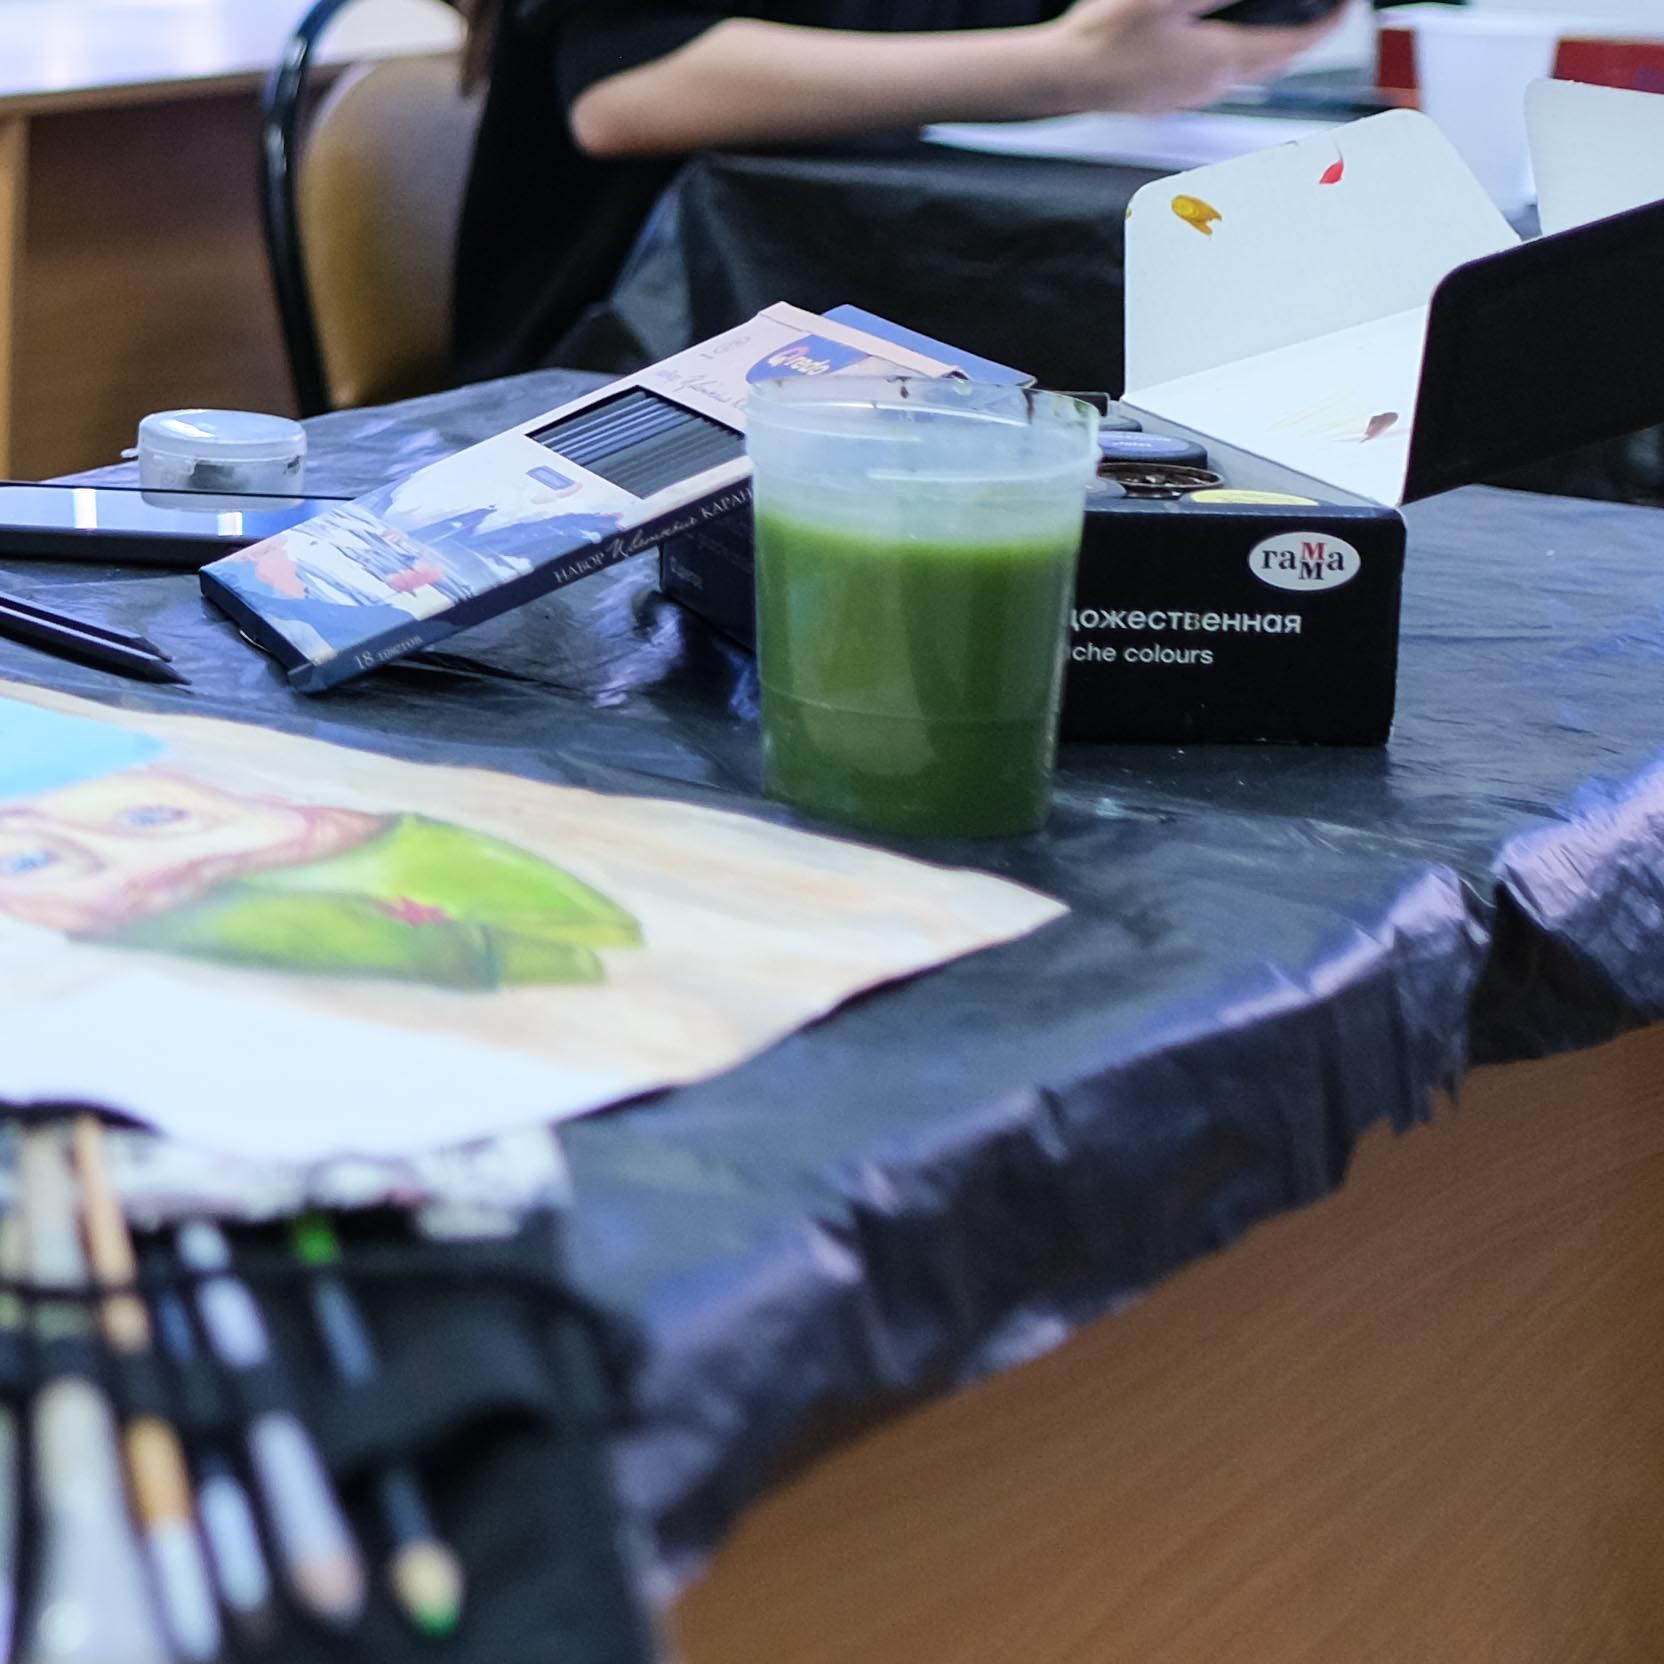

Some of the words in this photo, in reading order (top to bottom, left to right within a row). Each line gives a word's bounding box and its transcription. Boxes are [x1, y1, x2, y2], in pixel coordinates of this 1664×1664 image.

[700, 486, 754, 520] КАРАН
[1070, 641, 1117, 663] che
[1123, 642, 1215, 666] colours
